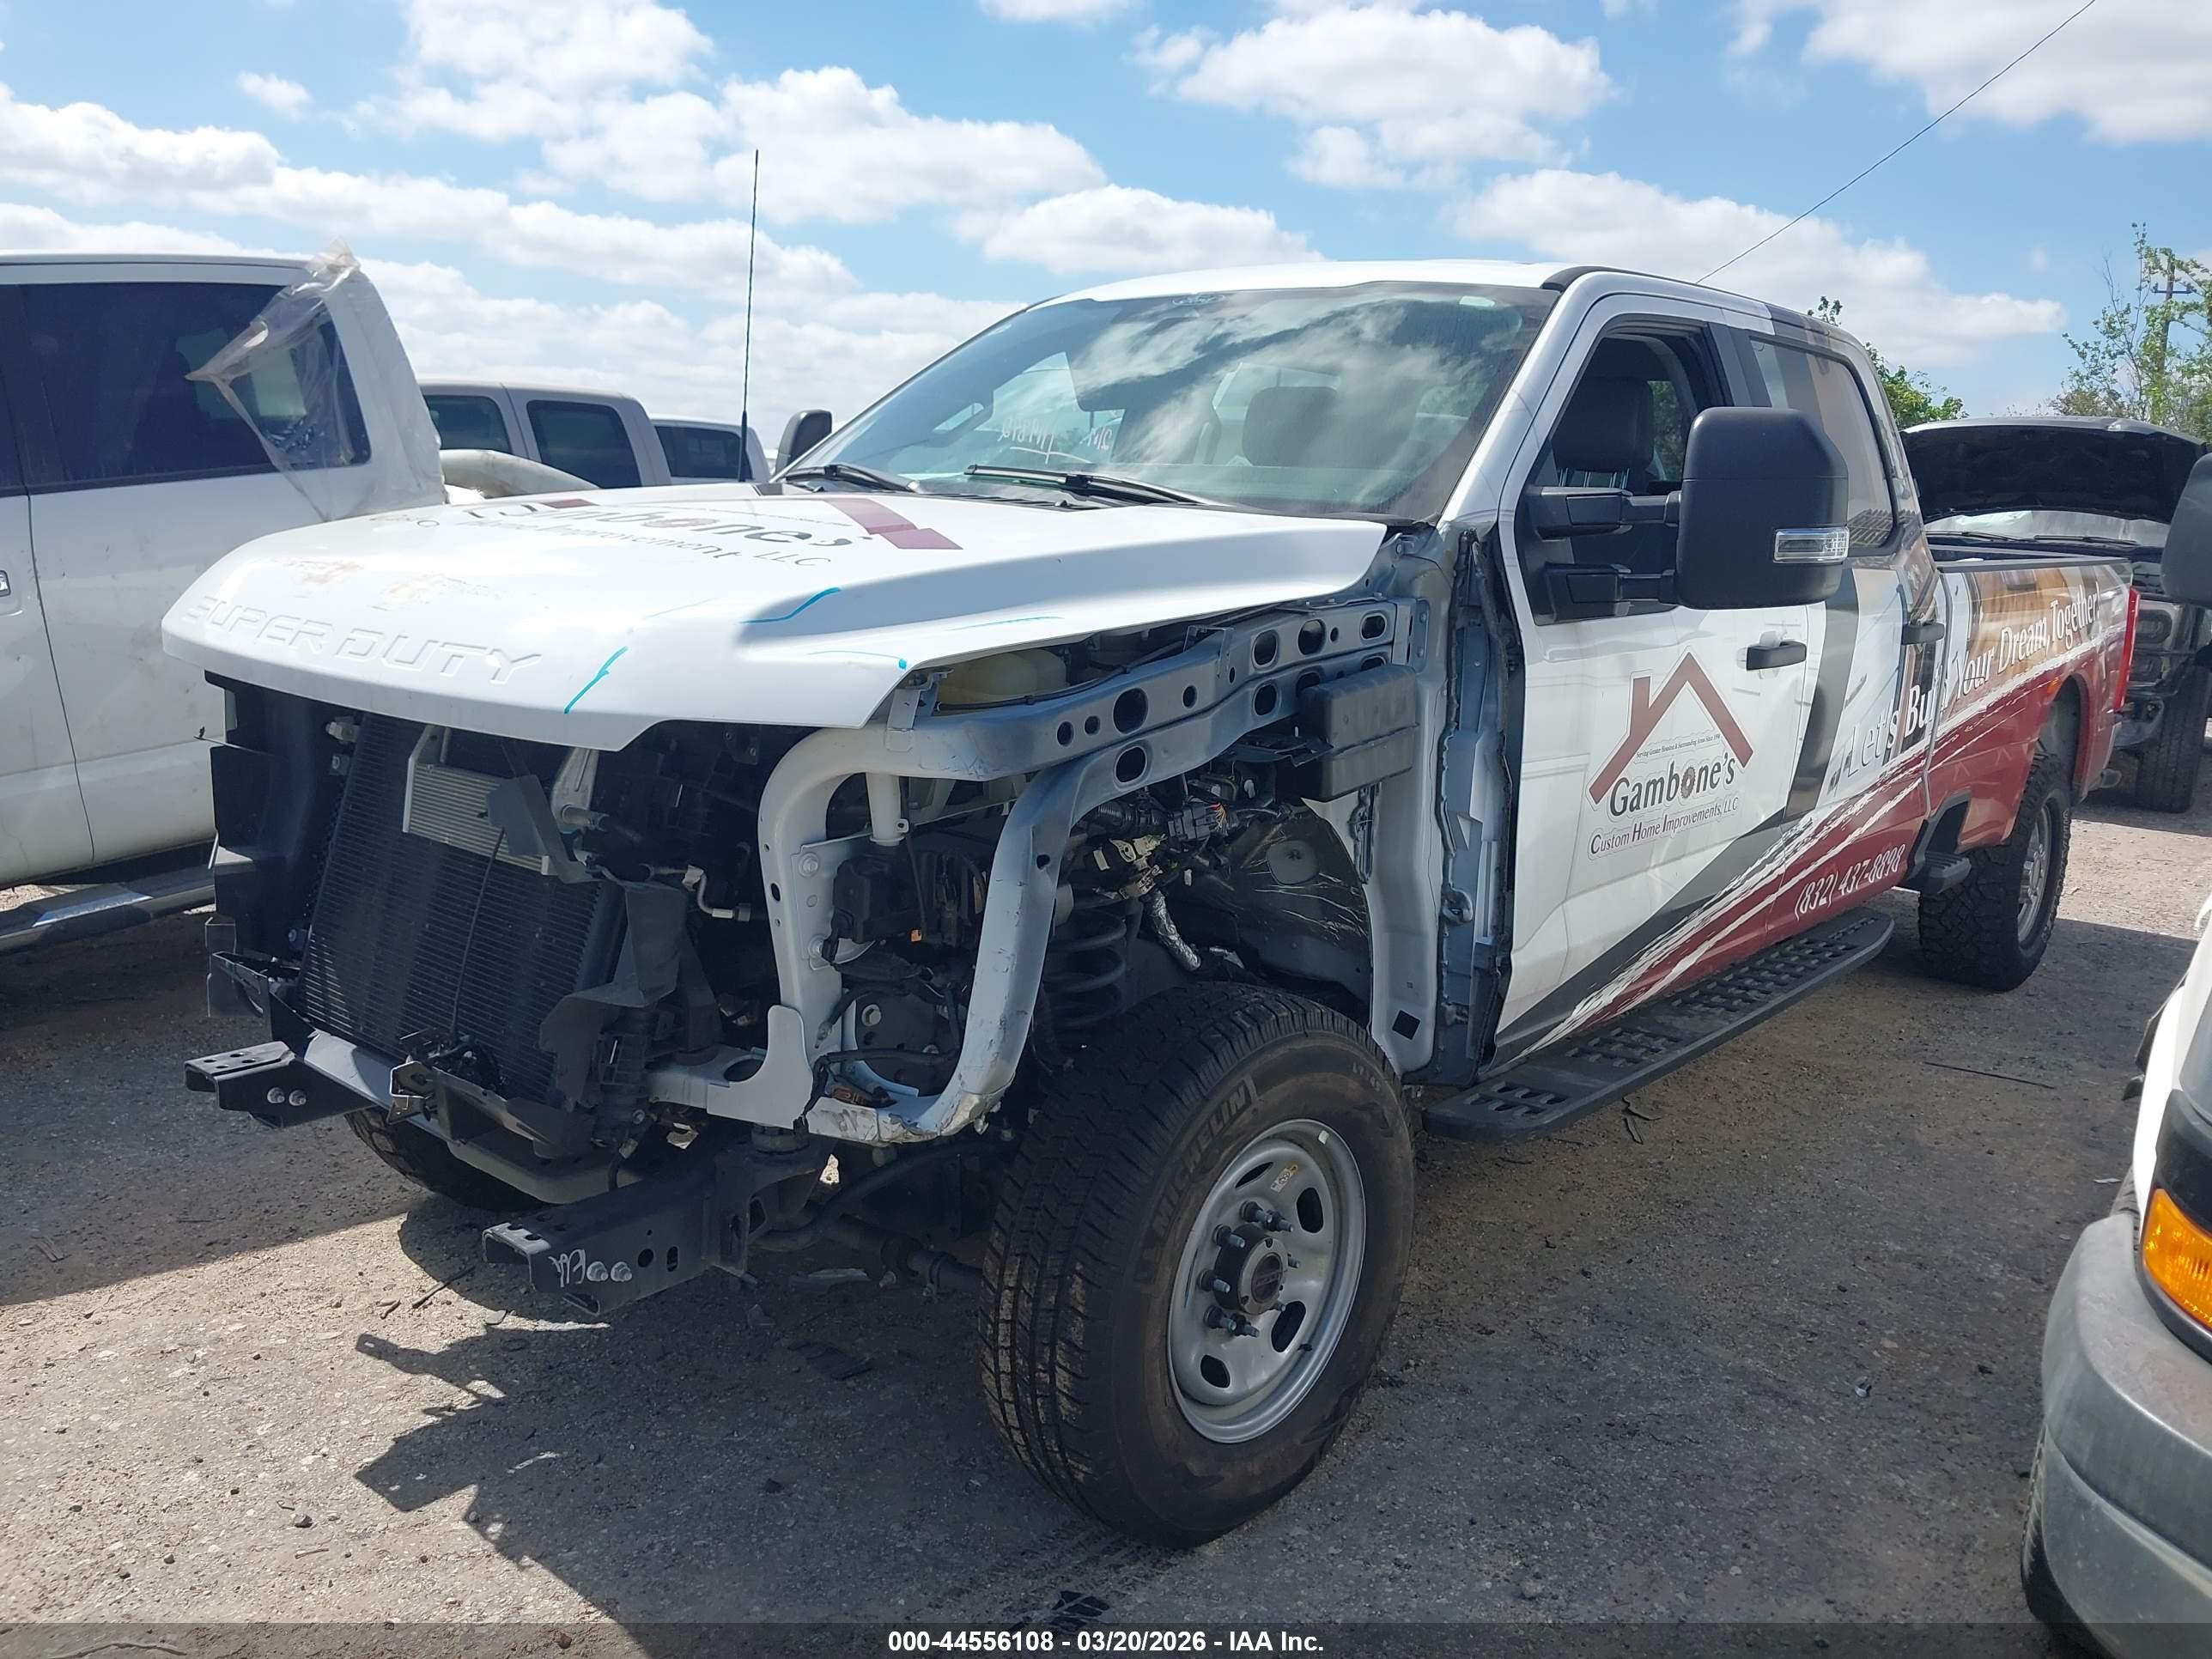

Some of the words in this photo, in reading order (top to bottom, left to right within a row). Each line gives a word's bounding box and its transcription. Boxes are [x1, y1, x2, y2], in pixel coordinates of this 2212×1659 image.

[753, 550, 832, 567] LLC
[183, 595, 336, 655] SUPER
[335, 628, 544, 685] DUTY
[1847, 706, 1899, 778] Let's
[1904, 663, 1951, 739] Buid
[1955, 646, 1995, 700] Your
[1997, 617, 2051, 674] Dream,
[2049, 580, 2100, 649] Together!
[1608, 751, 1735, 816] Gambone's
[1590, 830, 1630, 854] Custom
[1632, 821, 1661, 843] Home
[1662, 803, 1723, 834] Improvements,
[1723, 797, 1739, 813] LLC
[1794, 871, 1838, 921] (832)
[1838, 843, 1906, 896] 437-8898
[1152, 1080, 1249, 1238] MICHELIN
